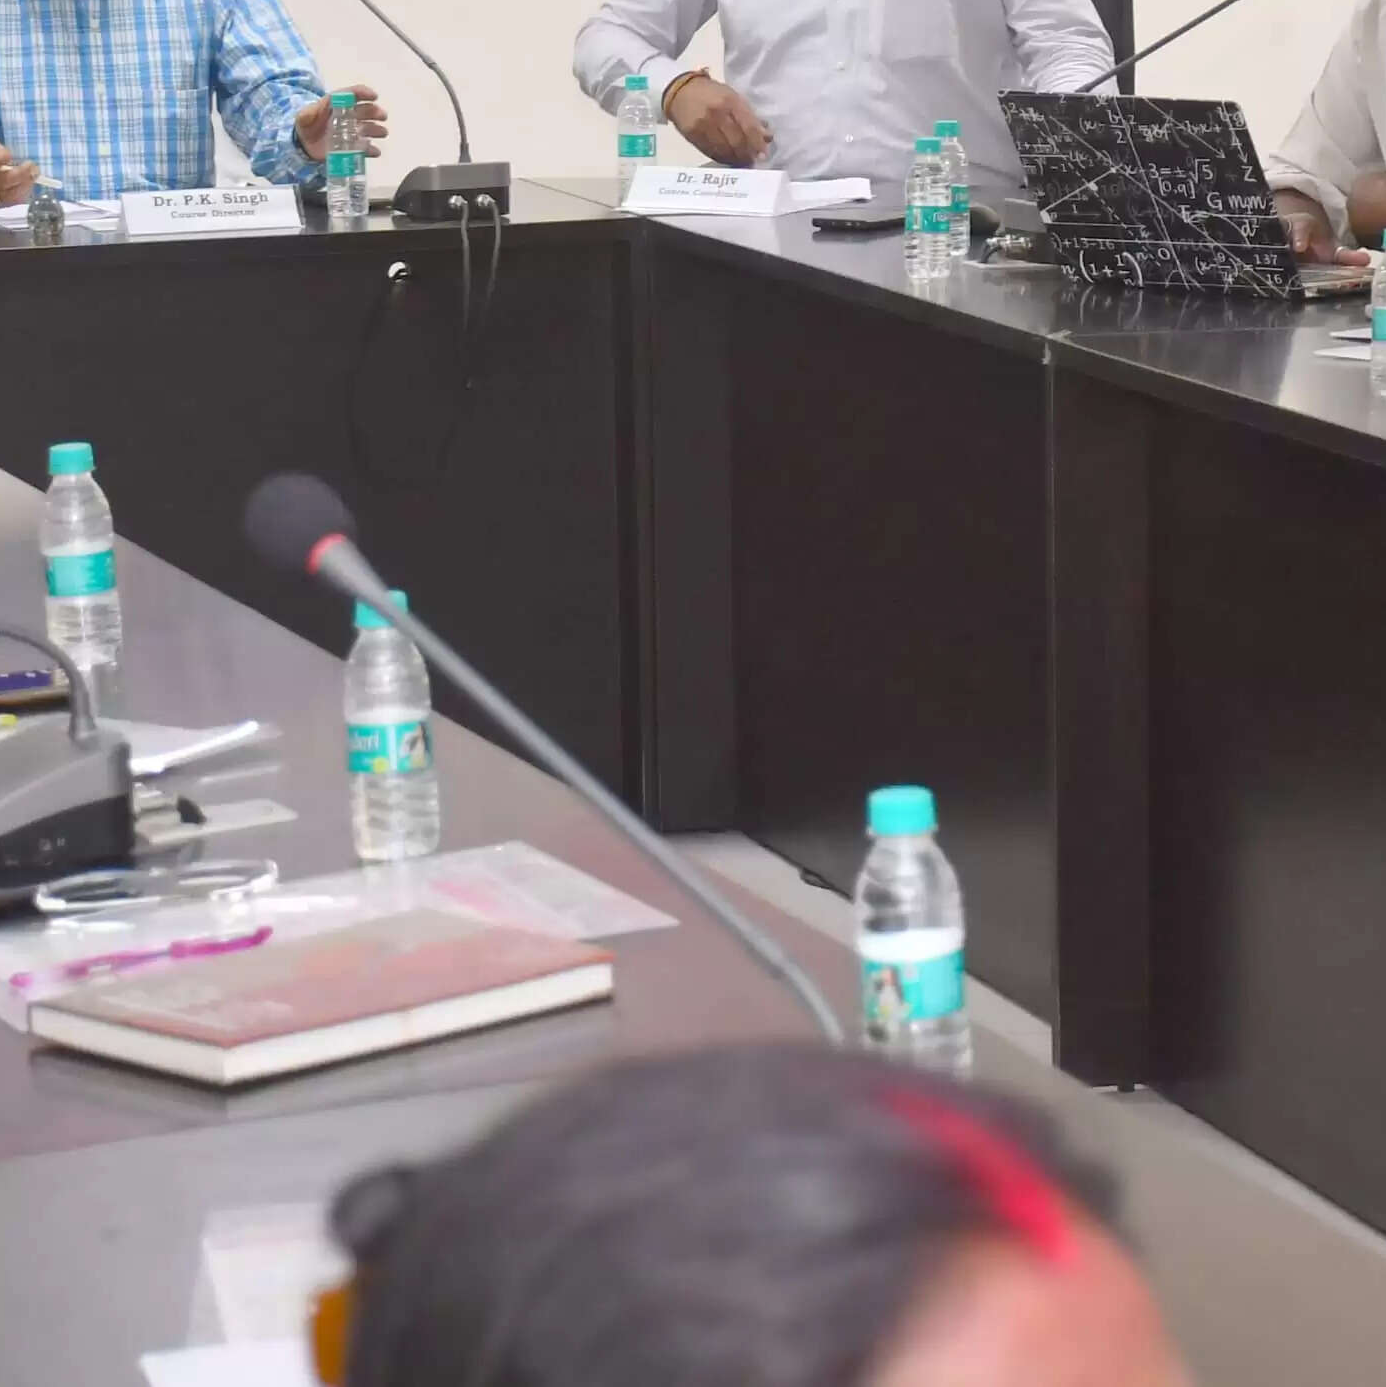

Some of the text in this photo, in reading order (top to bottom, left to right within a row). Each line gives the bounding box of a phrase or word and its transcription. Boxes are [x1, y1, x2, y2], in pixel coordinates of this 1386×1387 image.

[675, 171, 740, 189] Dr. Rajiv
[153, 192, 270, 208] Dr. P.K. Singh
